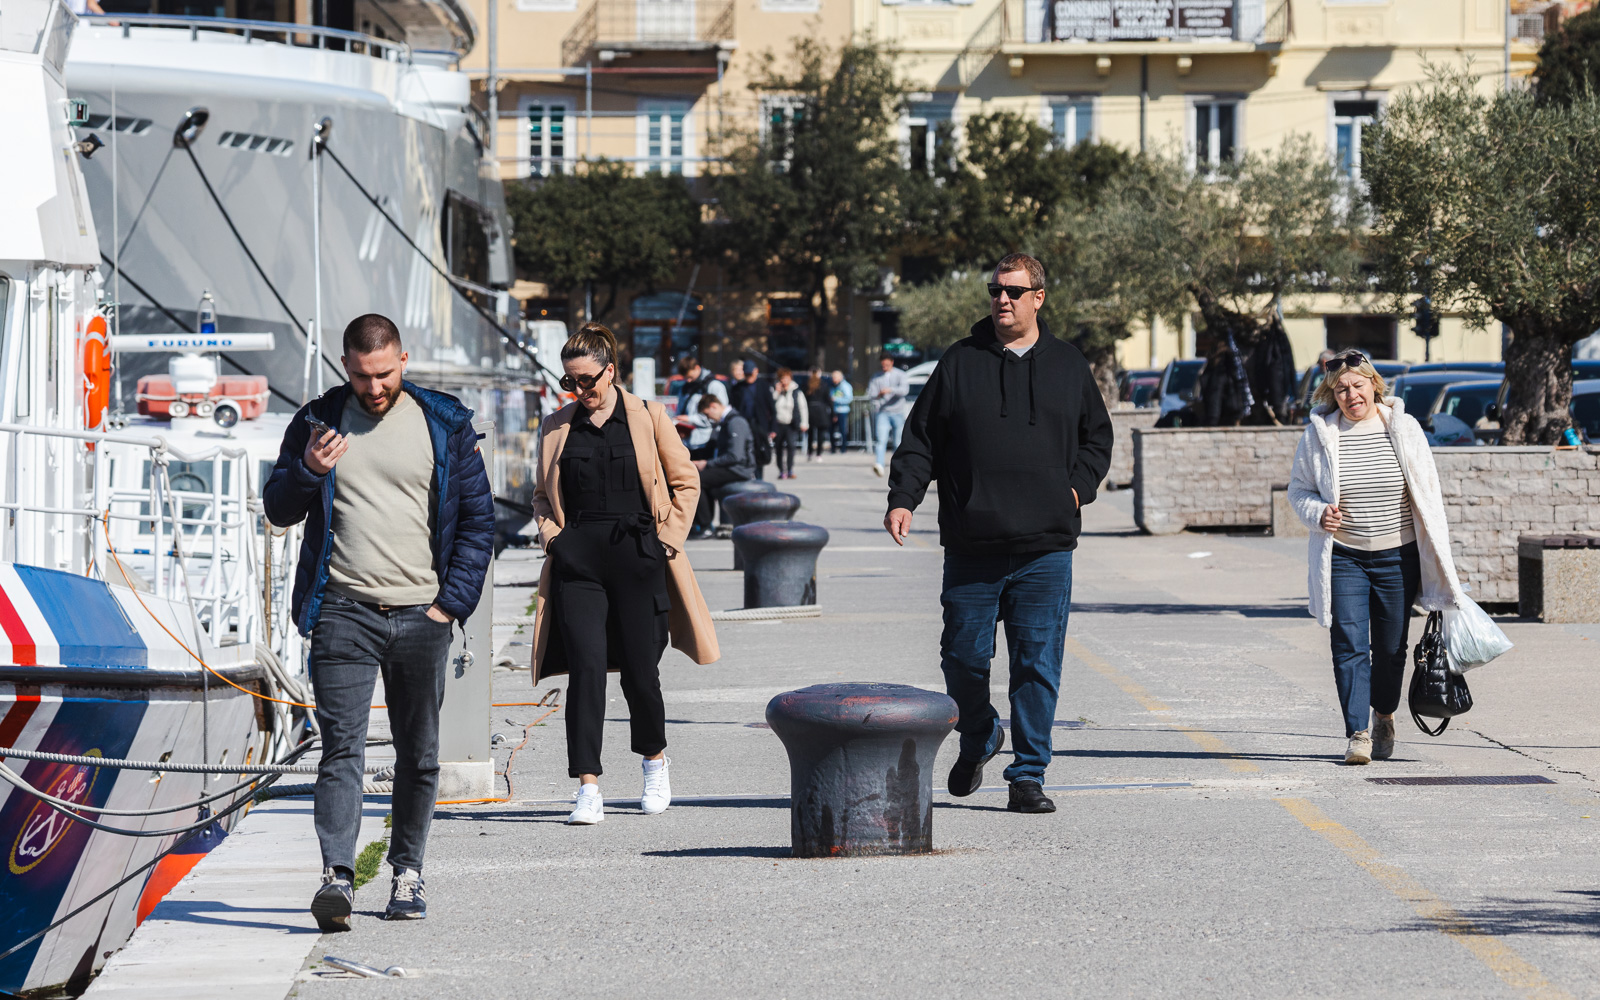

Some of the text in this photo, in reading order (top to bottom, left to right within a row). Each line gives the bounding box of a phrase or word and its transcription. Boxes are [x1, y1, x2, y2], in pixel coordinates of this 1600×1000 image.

[1114, 0, 1174, 8] PRODAJA
[1056, 1, 1110, 18] CONSENSUS
[1117, 9, 1170, 18] KUPNJA
[1120, 18, 1166, 26] NAJAM
[148, 339, 233, 347] FURUNO
